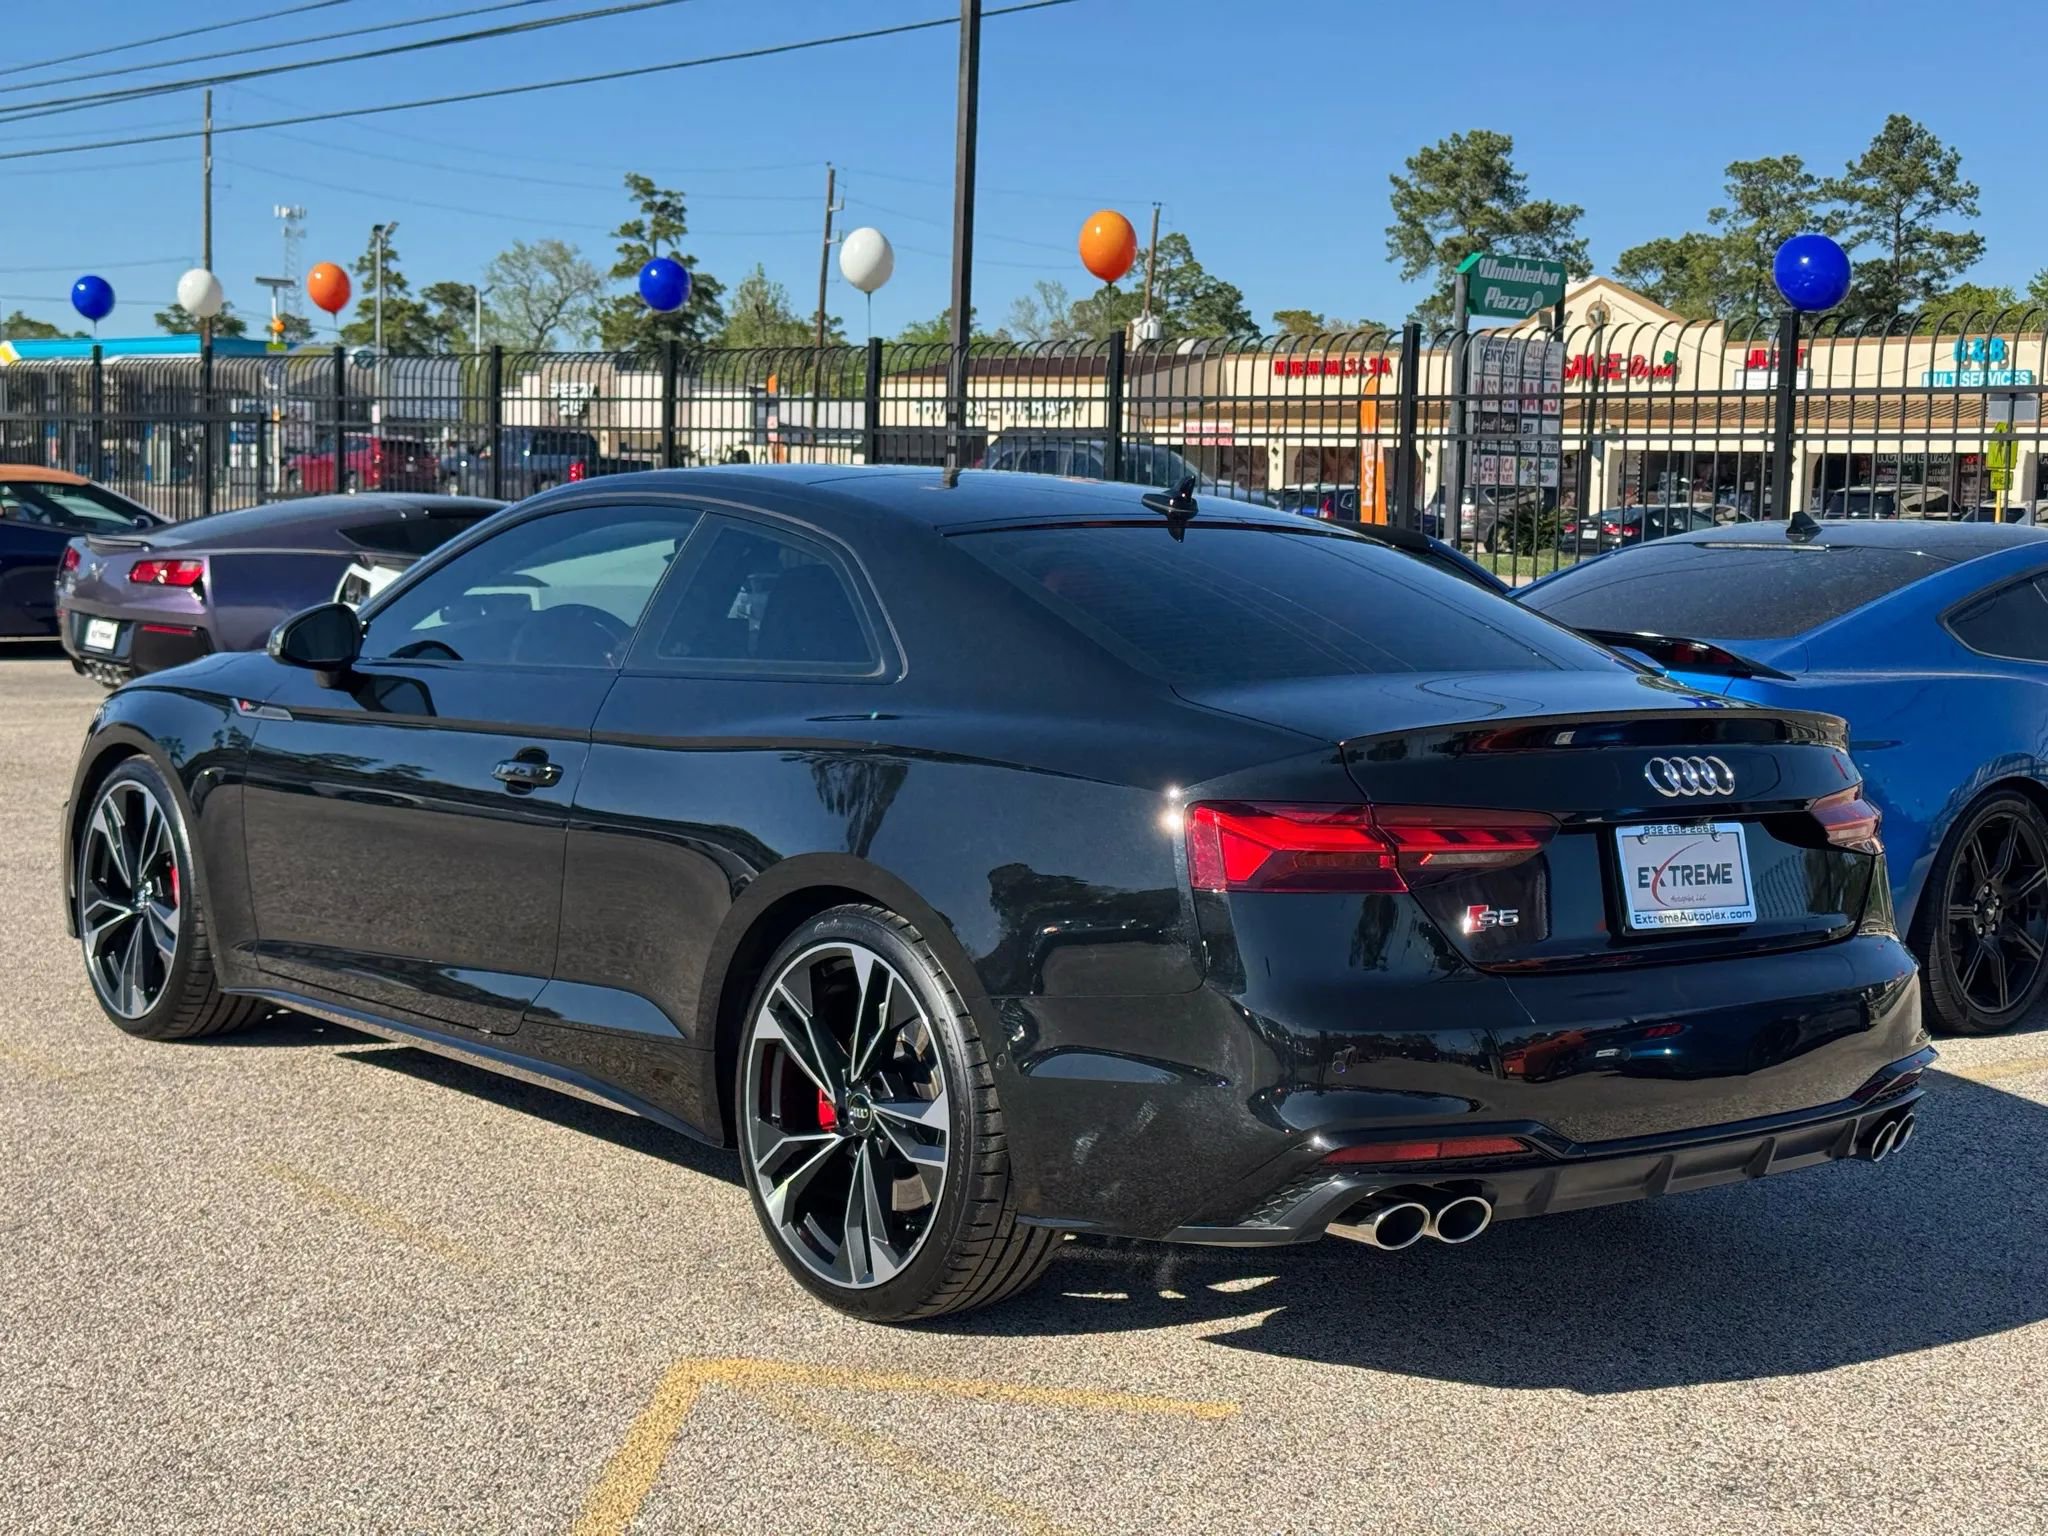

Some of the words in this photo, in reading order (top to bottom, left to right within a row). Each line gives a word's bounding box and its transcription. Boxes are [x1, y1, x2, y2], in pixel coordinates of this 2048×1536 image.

[1479, 258, 1561, 286] Wimbledon
[1484, 286, 1529, 311] Plaza
[1480, 347, 1516, 363] ENTST
[1989, 337, 2004, 361] B
[1275, 361, 1320, 376] MDERN
[1923, 372, 2030, 387] MULTSERVICES
[1483, 457, 1514, 474] CLIICA
[1637, 863, 1733, 889] EXTREME
[1478, 909, 1520, 928] S5
[1634, 909, 1753, 925] ExtremeAutoplex.com
